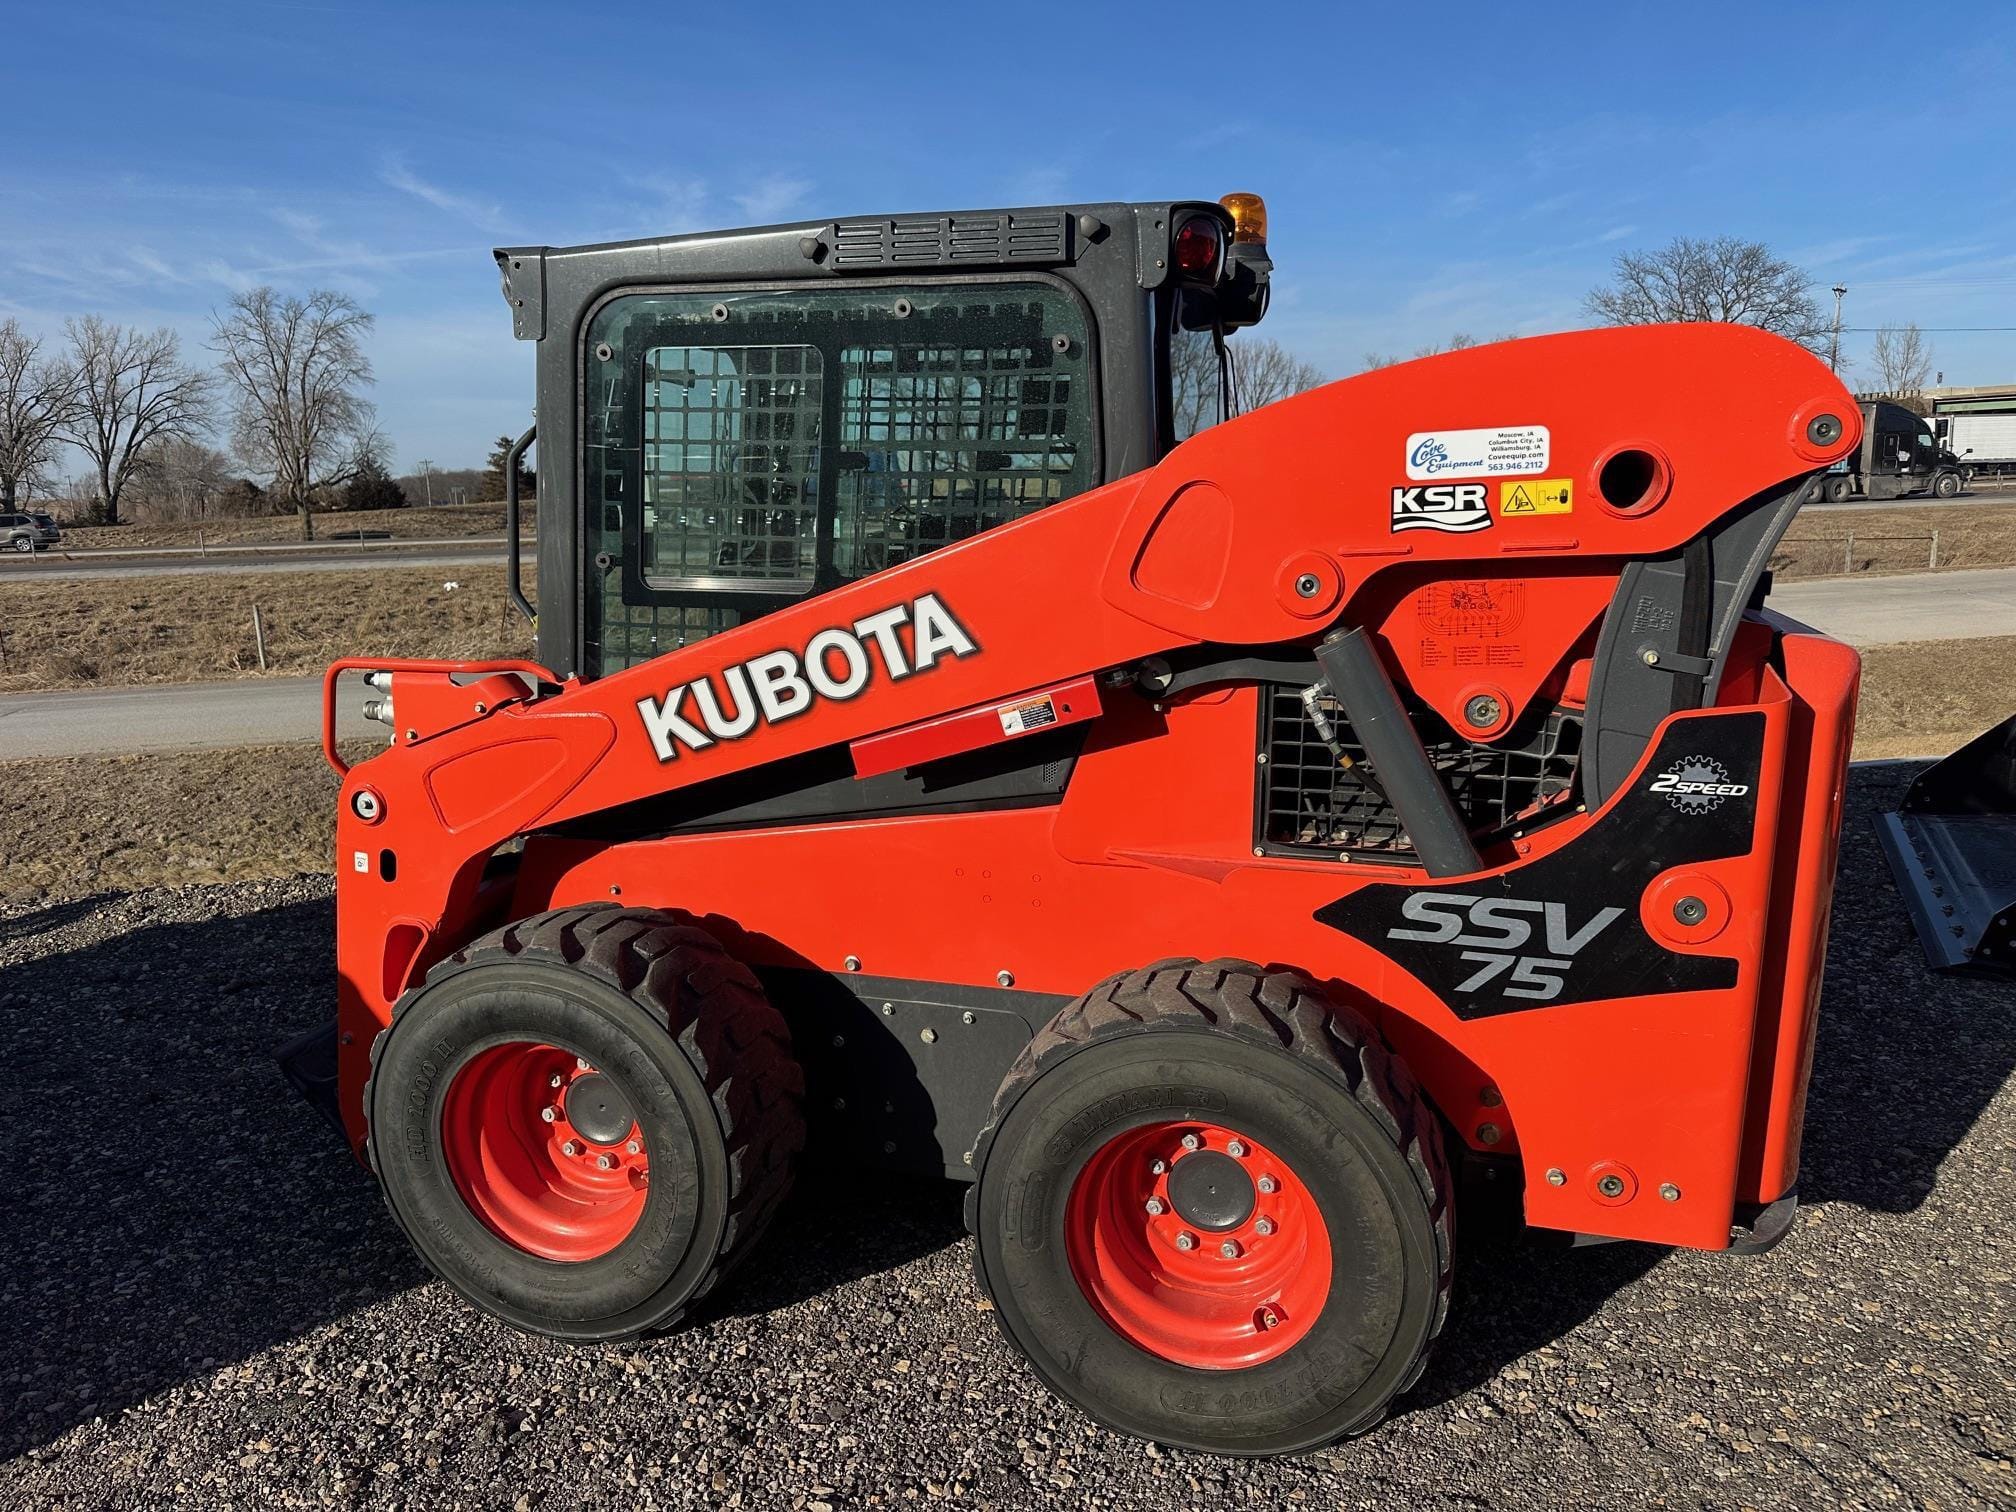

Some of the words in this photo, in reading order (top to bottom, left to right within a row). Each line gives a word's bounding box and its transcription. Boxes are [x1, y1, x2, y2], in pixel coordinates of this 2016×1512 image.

[1411, 438, 1447, 467] Cove
[1427, 458, 1484, 473] Equipment
[1488, 452, 1544, 461] Coveequip.com
[1488, 461, 1543, 471] 563.946.2112
[1393, 484, 1487, 513] KSR
[636, 593, 978, 763] KUBOTA
[1386, 891, 1626, 956] SSV
[1453, 950, 1573, 1000] 75
[407, 1059, 438, 1118] 2000
